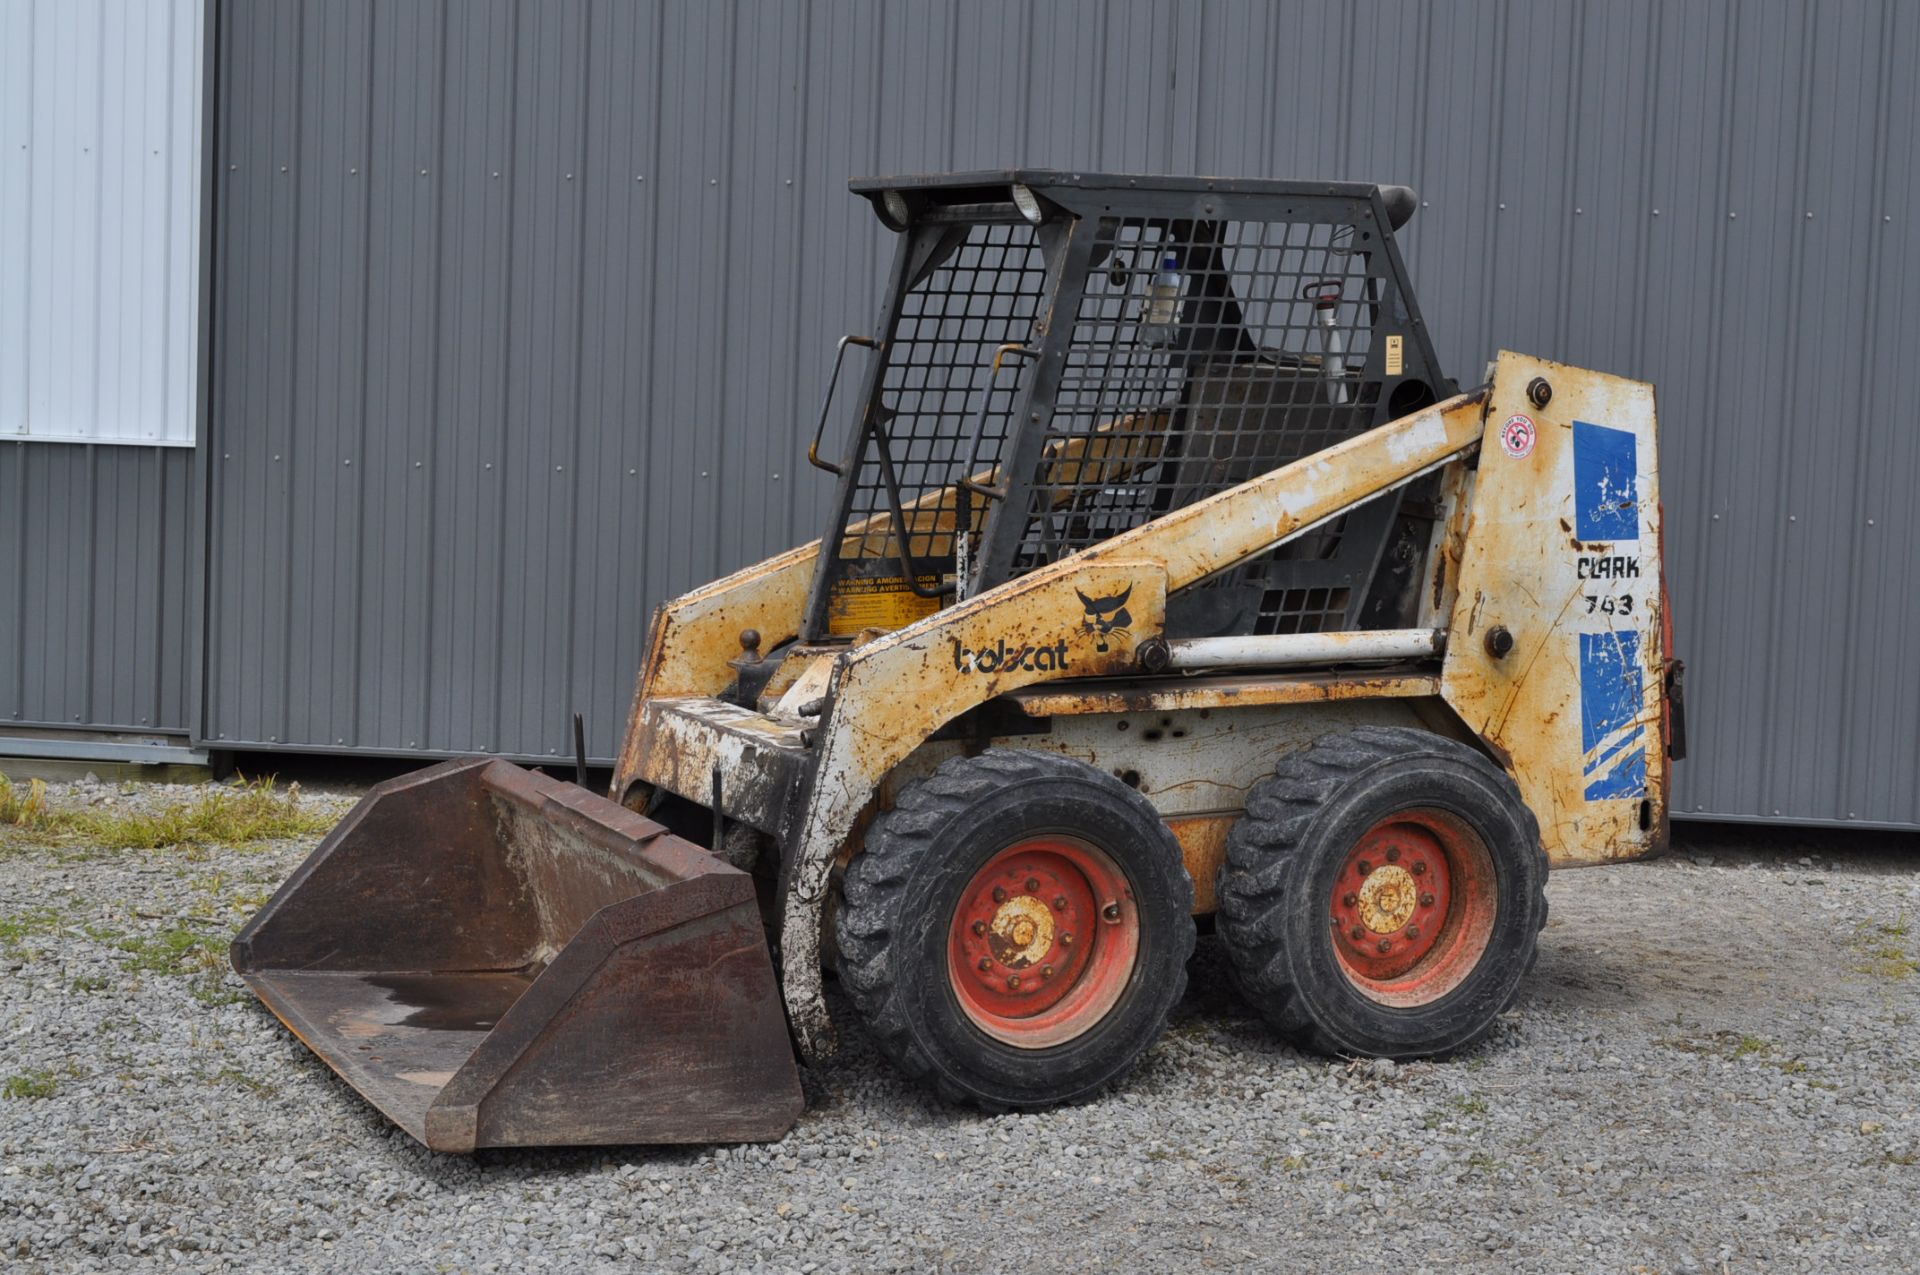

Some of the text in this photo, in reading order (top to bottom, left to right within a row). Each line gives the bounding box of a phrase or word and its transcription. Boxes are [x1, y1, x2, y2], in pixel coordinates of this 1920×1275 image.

[1516, 416, 1528, 424] YOU
[1577, 556, 1640, 580] CLARK
[1584, 594, 1634, 616] 743
[954, 638, 1069, 674] bobcat
